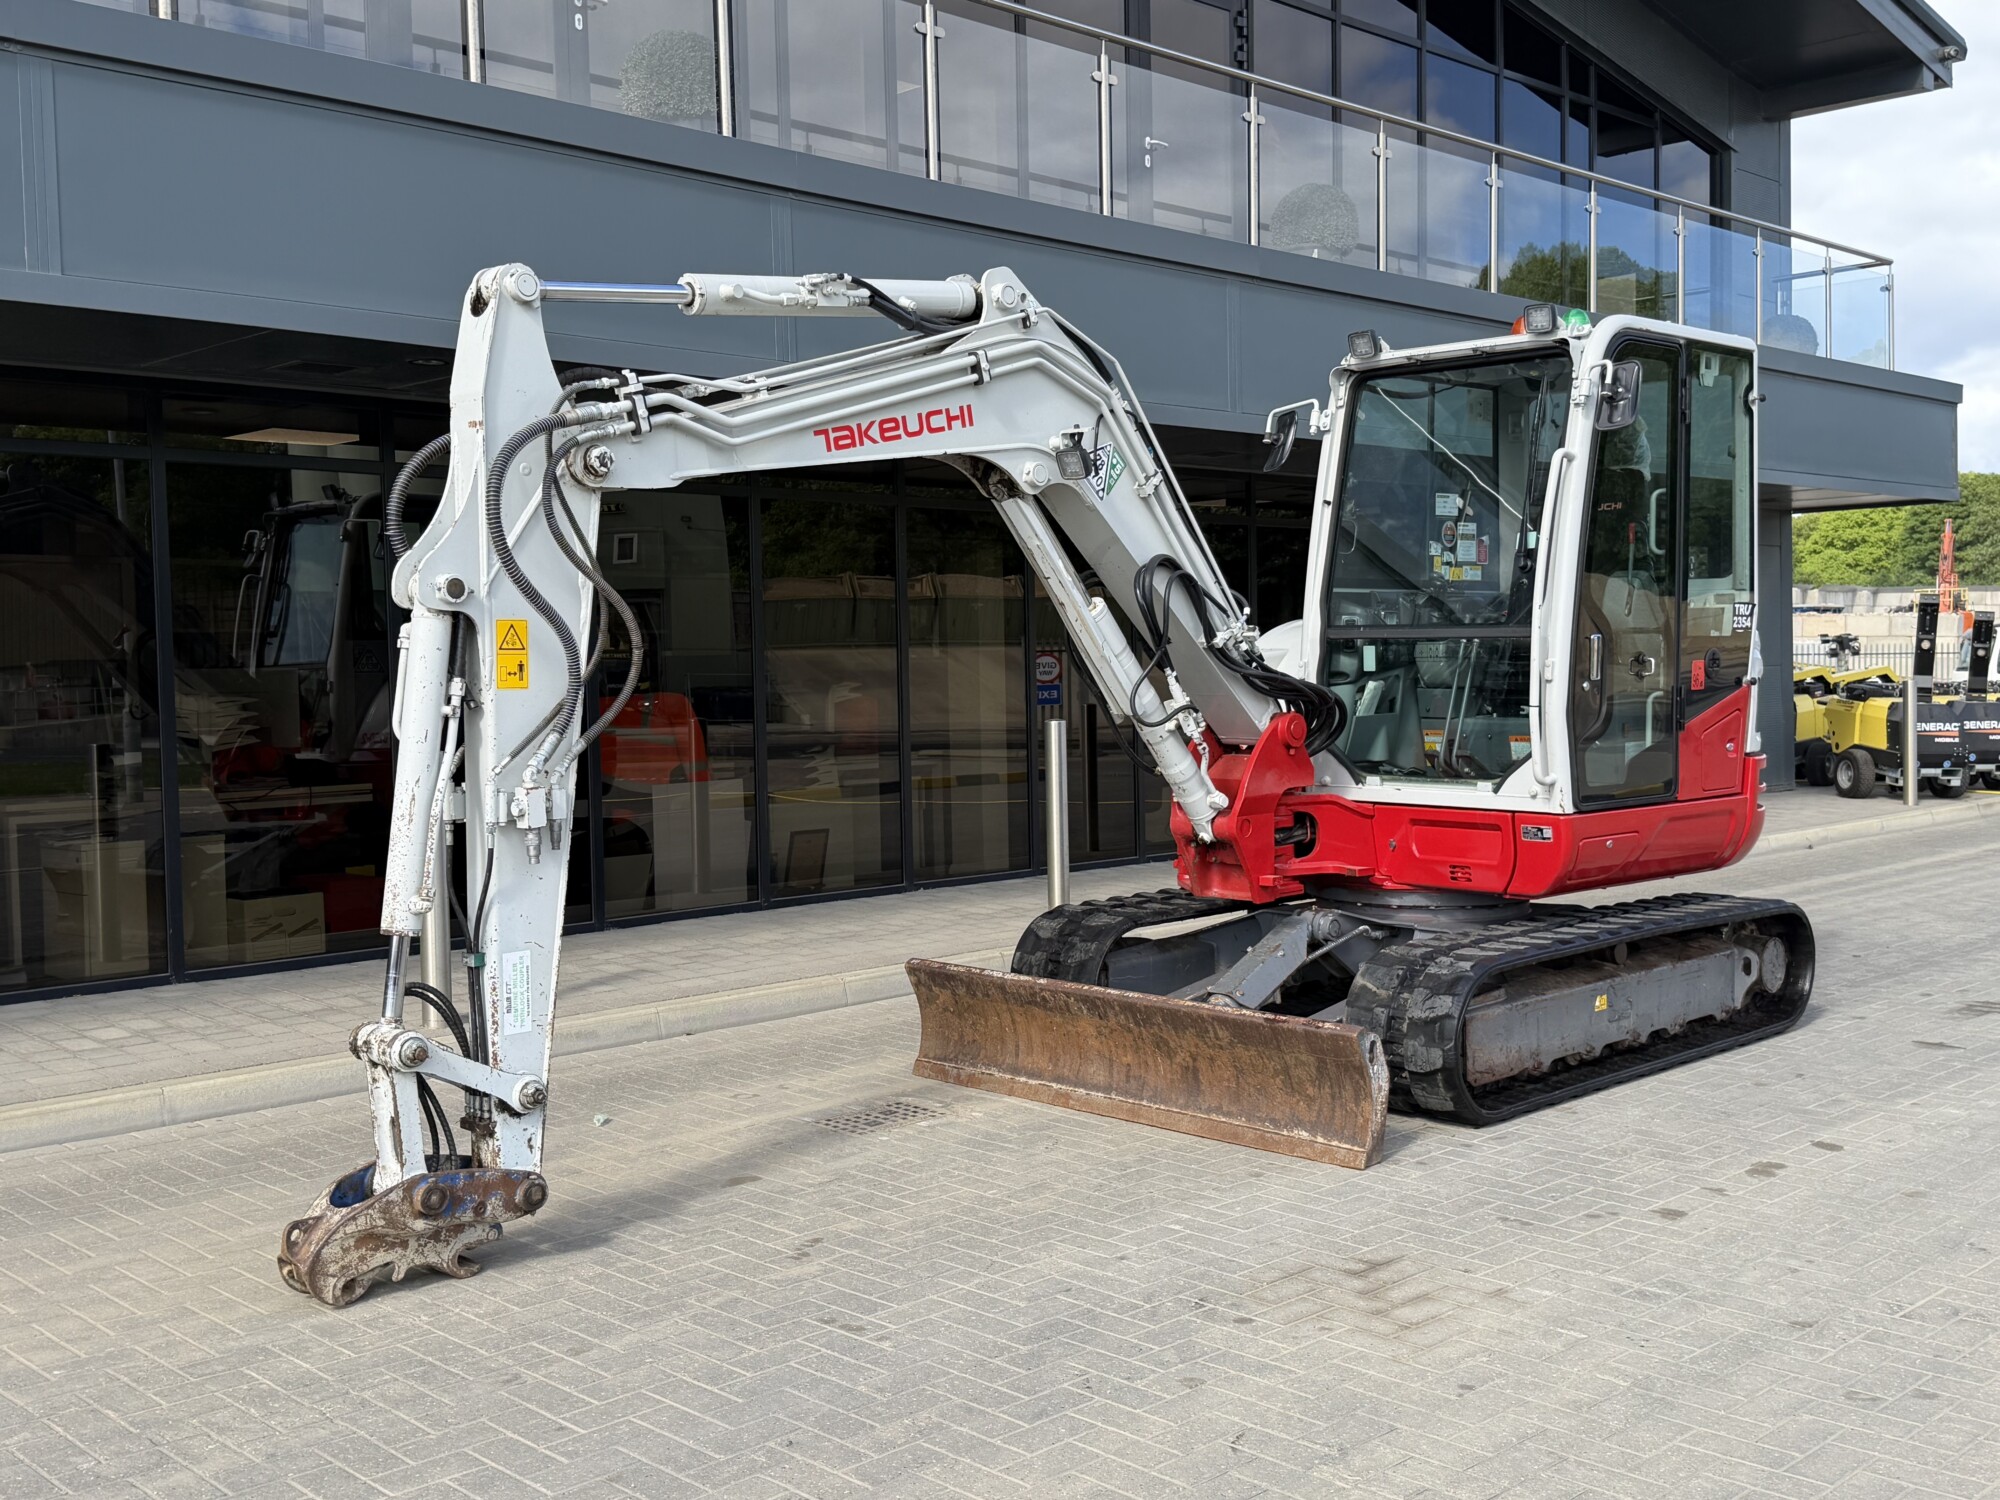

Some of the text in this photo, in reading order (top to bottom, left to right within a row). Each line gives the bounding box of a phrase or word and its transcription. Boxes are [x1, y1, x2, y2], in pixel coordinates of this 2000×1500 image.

[813, 403, 975, 453] TAKEUCHI
[1734, 604, 1752, 615] TRU
[1733, 617, 1751, 628] 2354
[1917, 723, 1959, 731] ENERAC
